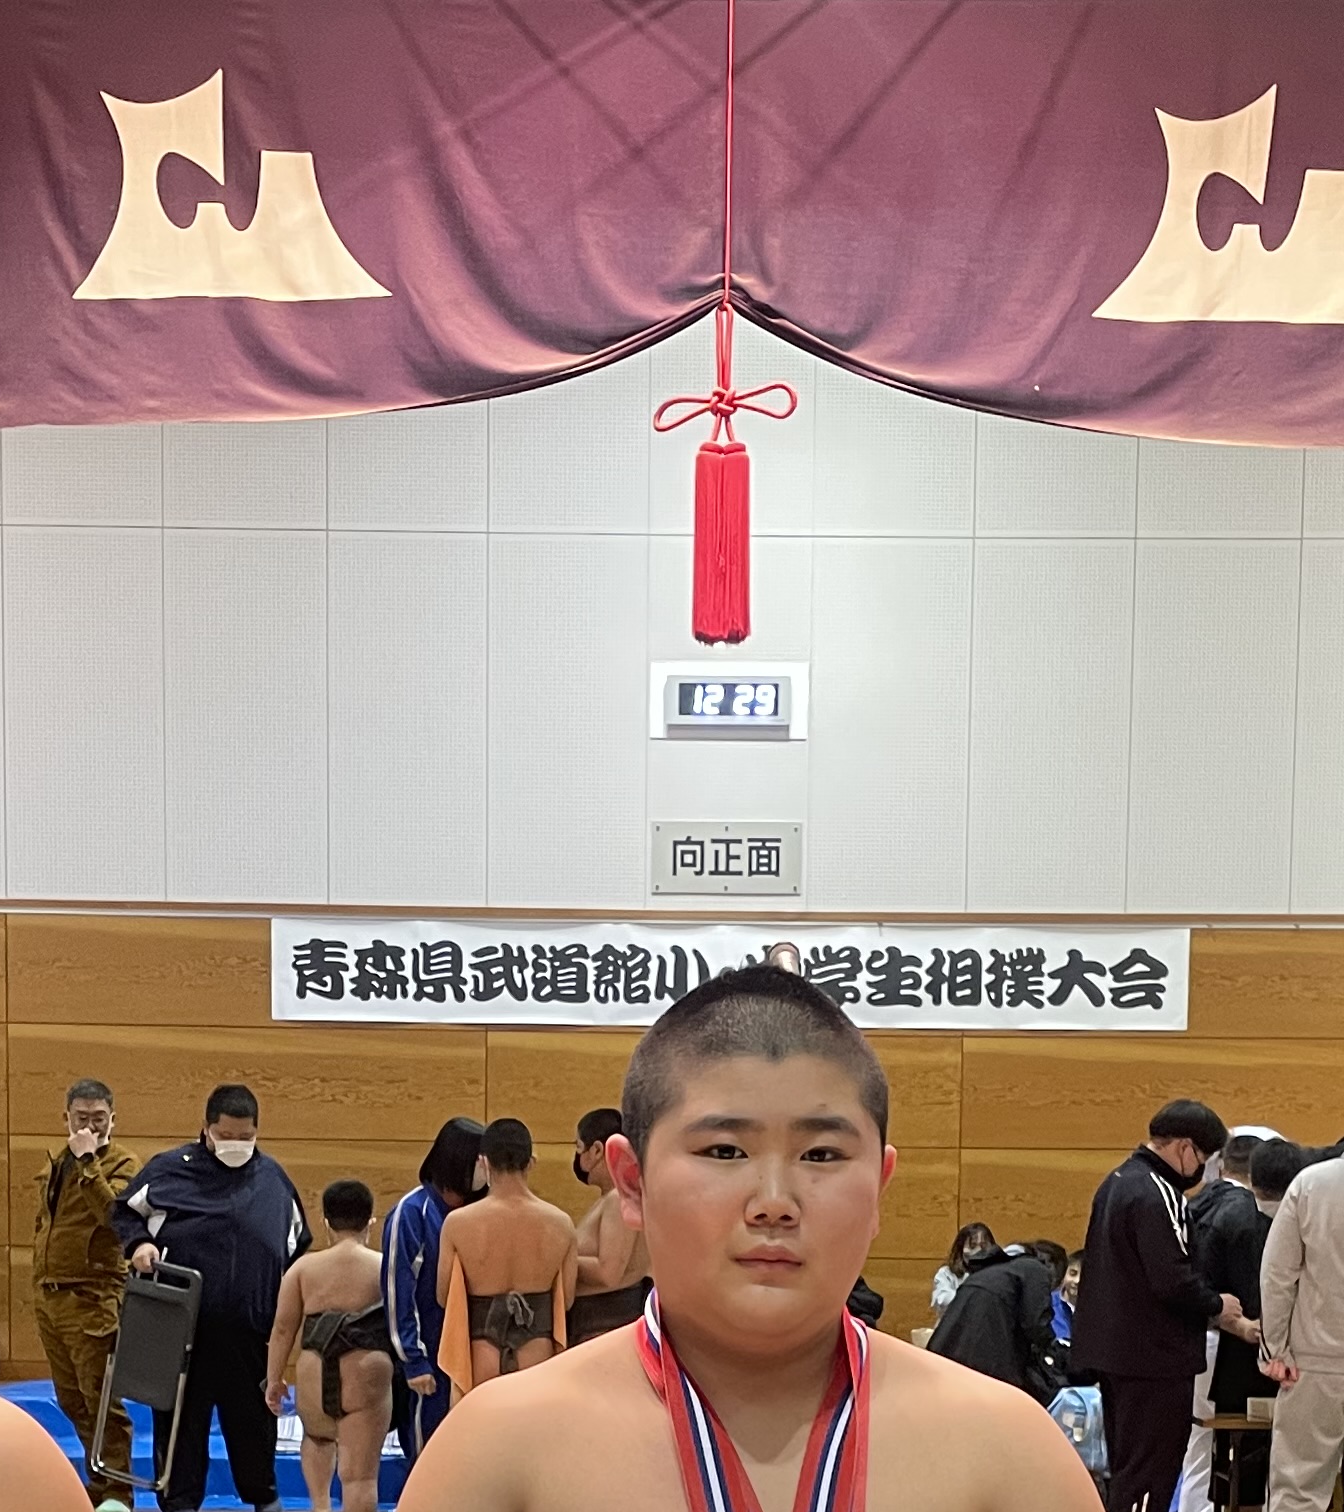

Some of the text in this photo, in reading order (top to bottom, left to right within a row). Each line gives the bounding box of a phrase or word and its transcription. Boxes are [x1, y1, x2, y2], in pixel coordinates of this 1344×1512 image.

[692, 683, 777, 716] 12 29
[672, 835, 782, 878] 向正面
[291, 938, 1169, 1009] 青森県武道館小学生相撲大会
